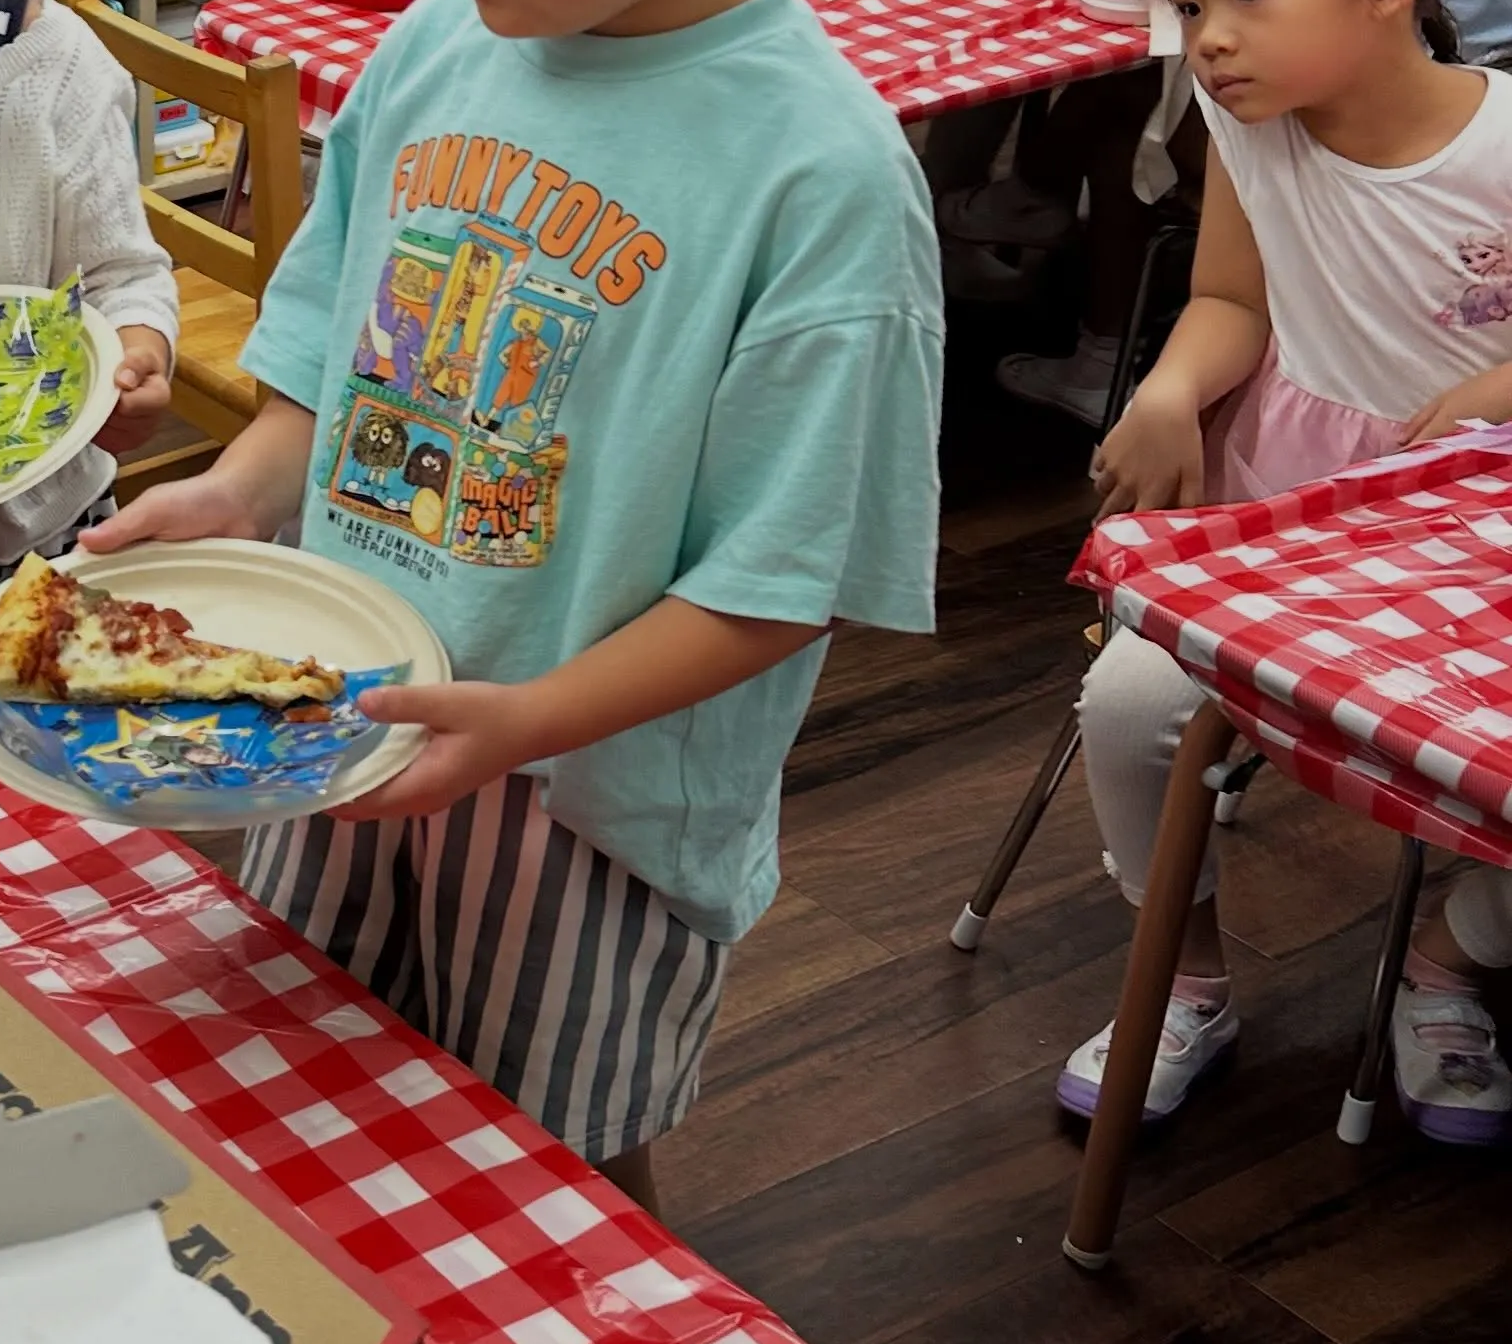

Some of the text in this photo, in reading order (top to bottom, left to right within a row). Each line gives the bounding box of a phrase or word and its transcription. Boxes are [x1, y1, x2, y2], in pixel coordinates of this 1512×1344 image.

[389, 133, 534, 219] FUNNY
[513, 158, 667, 306] TOYS
[327, 507, 344, 527] WE
[346, 519, 373, 541] ARE
[376, 528, 420, 560] FUNNY
[343, 531, 368, 550] LET'S
[369, 542, 392, 561] PLAY
